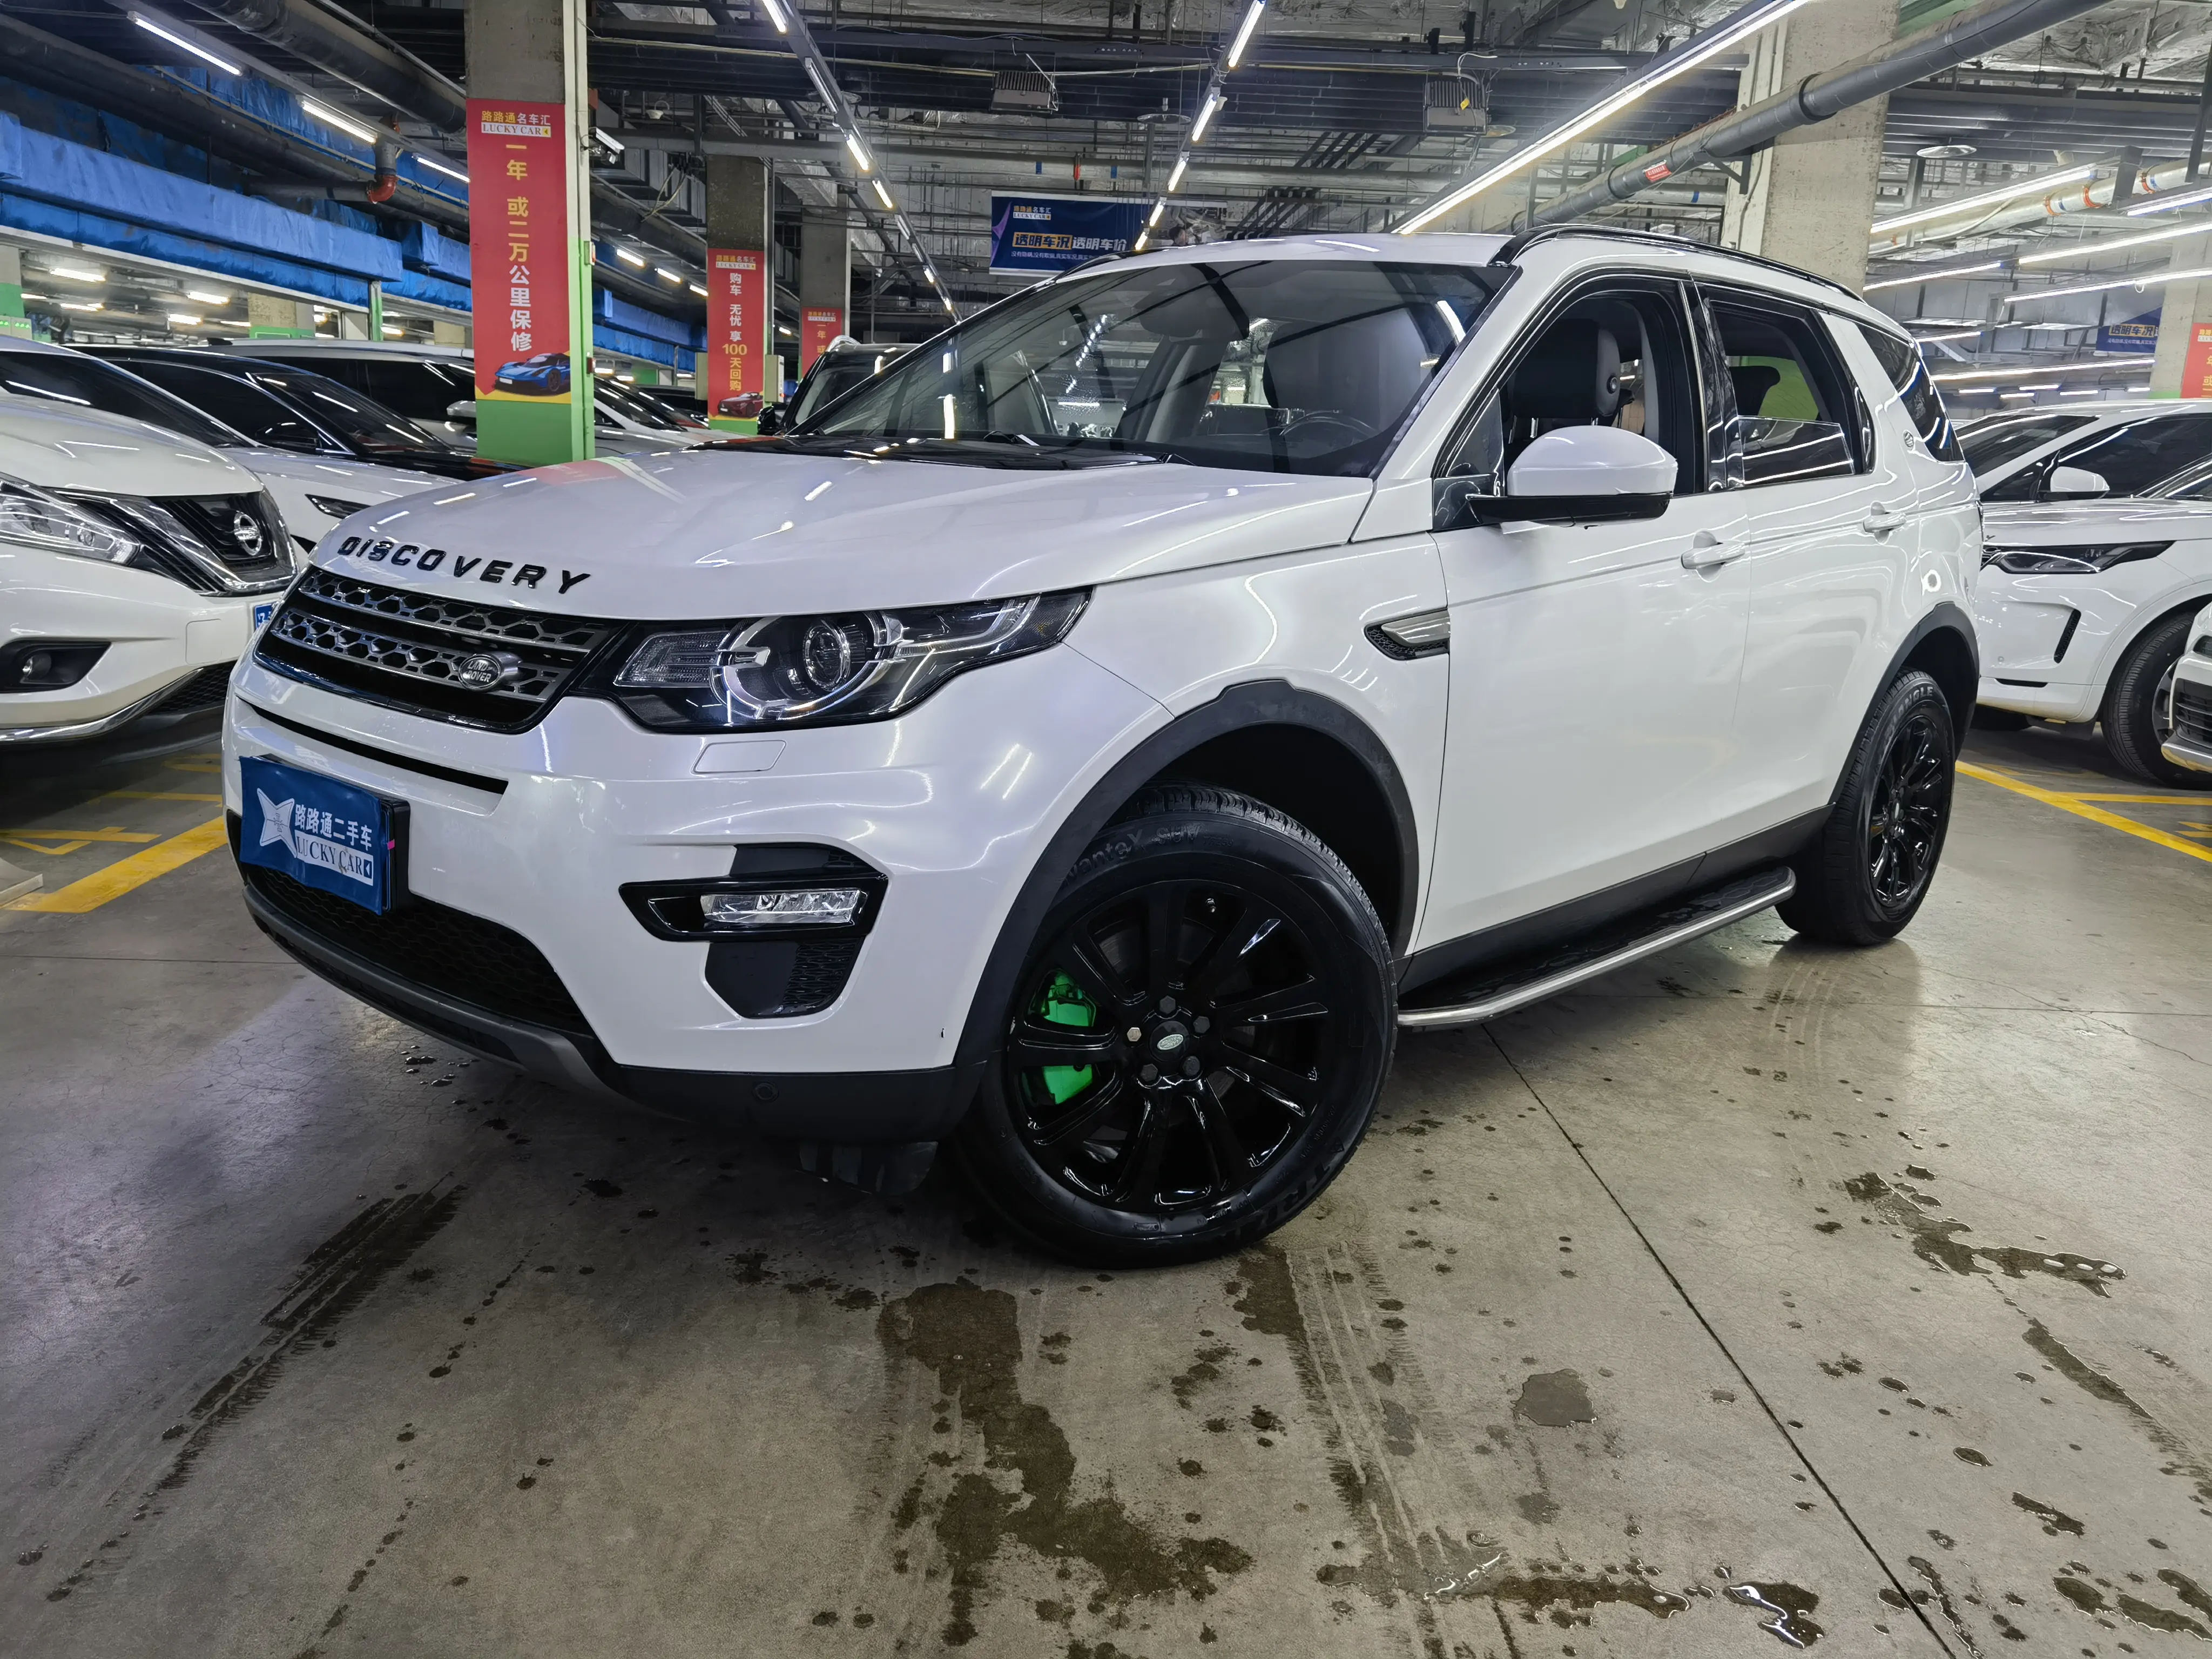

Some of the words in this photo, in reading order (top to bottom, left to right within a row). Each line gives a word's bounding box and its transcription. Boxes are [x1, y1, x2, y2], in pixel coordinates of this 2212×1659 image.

[482, 110, 551, 125] 路路通名车汇
[483, 124, 518, 133] LUCKY
[521, 126, 542, 135] CAR
[338, 536, 591, 594] DISCOVERY
[467, 660, 489, 671] LAND
[467, 670, 491, 683] ROVER
[295, 804, 372, 851] 路路通二手车
[296, 835, 336, 865] LUCKY
[339, 850, 362, 875] CAR
